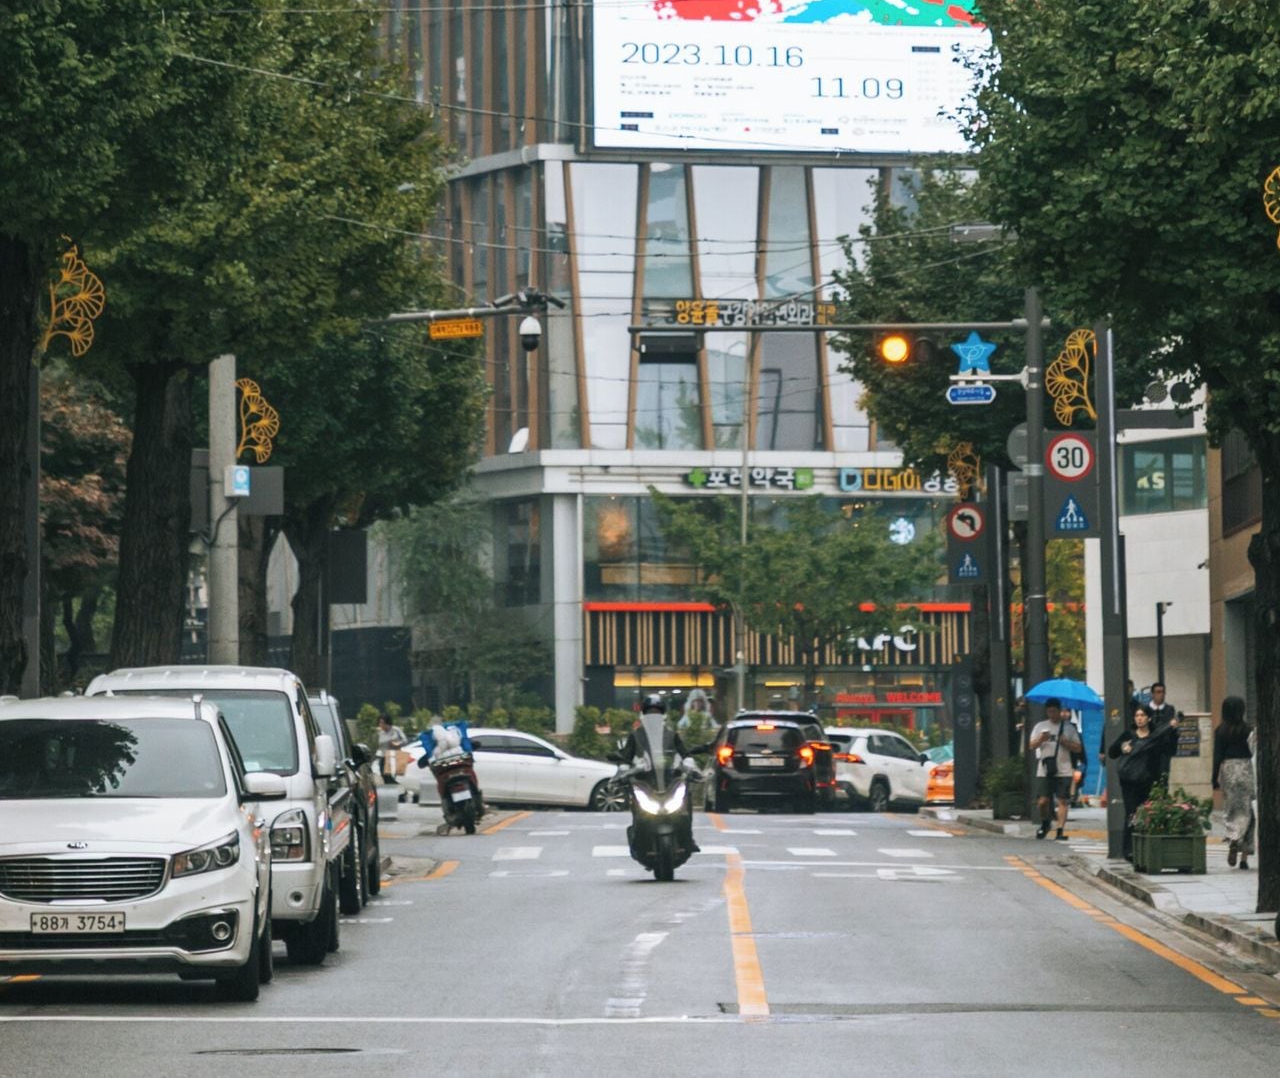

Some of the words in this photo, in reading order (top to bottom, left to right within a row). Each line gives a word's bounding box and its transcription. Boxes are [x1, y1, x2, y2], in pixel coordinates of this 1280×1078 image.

[621, 42, 803, 68] 2023.10.16
[811, 77, 903, 99] 11.09
[1056, 446, 1084, 469] 30
[885, 691, 943, 704] WELCOME
[76, 915, 117, 931] 3754
